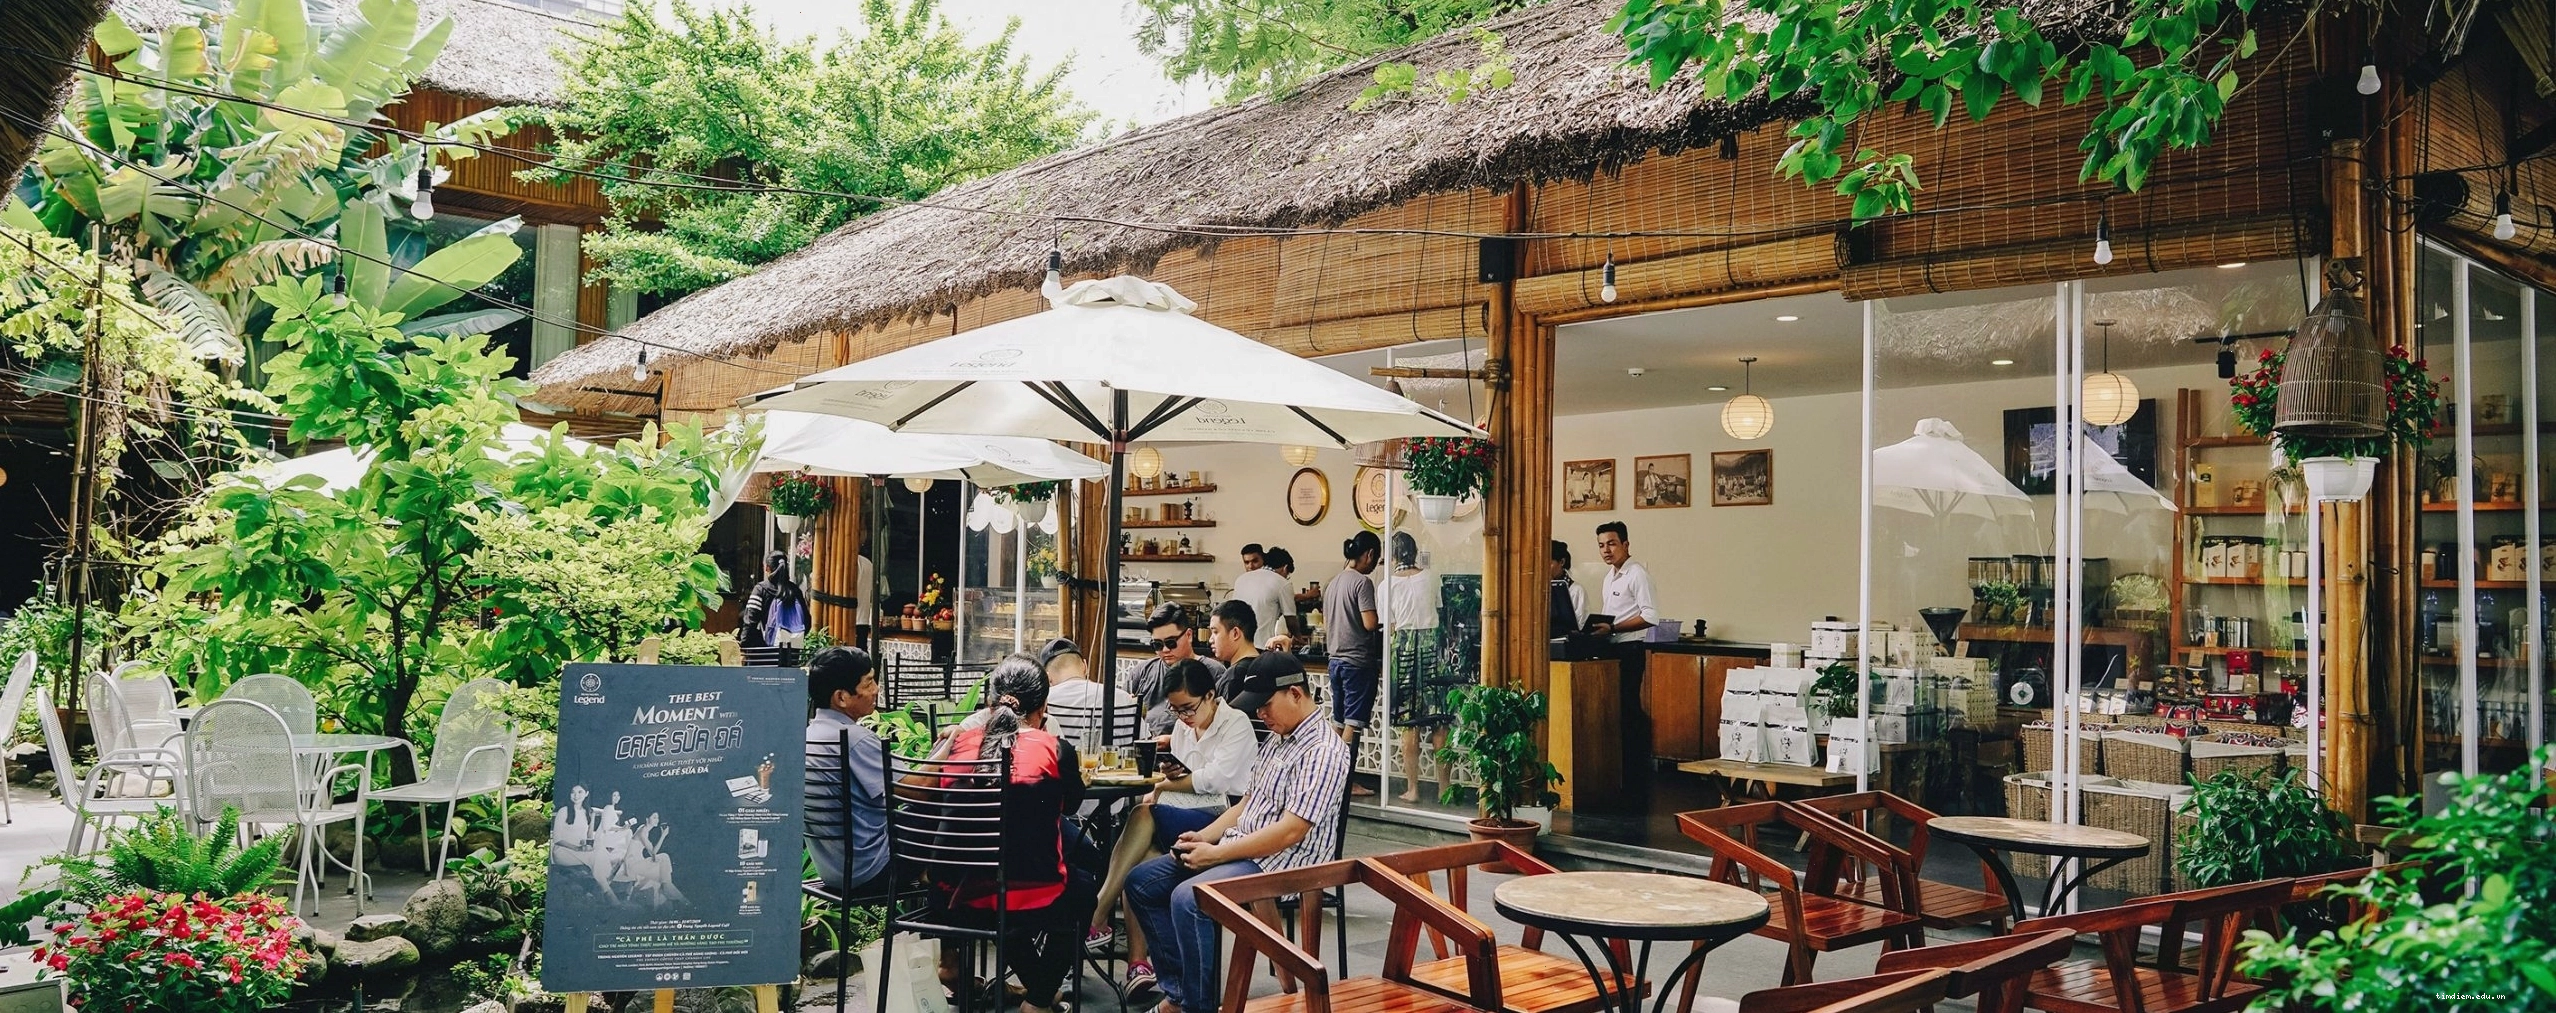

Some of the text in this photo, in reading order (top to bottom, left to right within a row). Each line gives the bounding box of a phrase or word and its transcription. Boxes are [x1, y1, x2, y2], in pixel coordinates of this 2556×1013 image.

[1366, 502, 1386, 514] Lege
[573, 695, 605, 706] Legend
[668, 691, 723, 704] THE BEST
[615, 719, 744, 760] CAFÉ SỮA ĐÁ
[660, 767, 681, 777] CAFÉ
[681, 765, 696, 776] SỮA
[697, 763, 709, 774] ĐÁ
